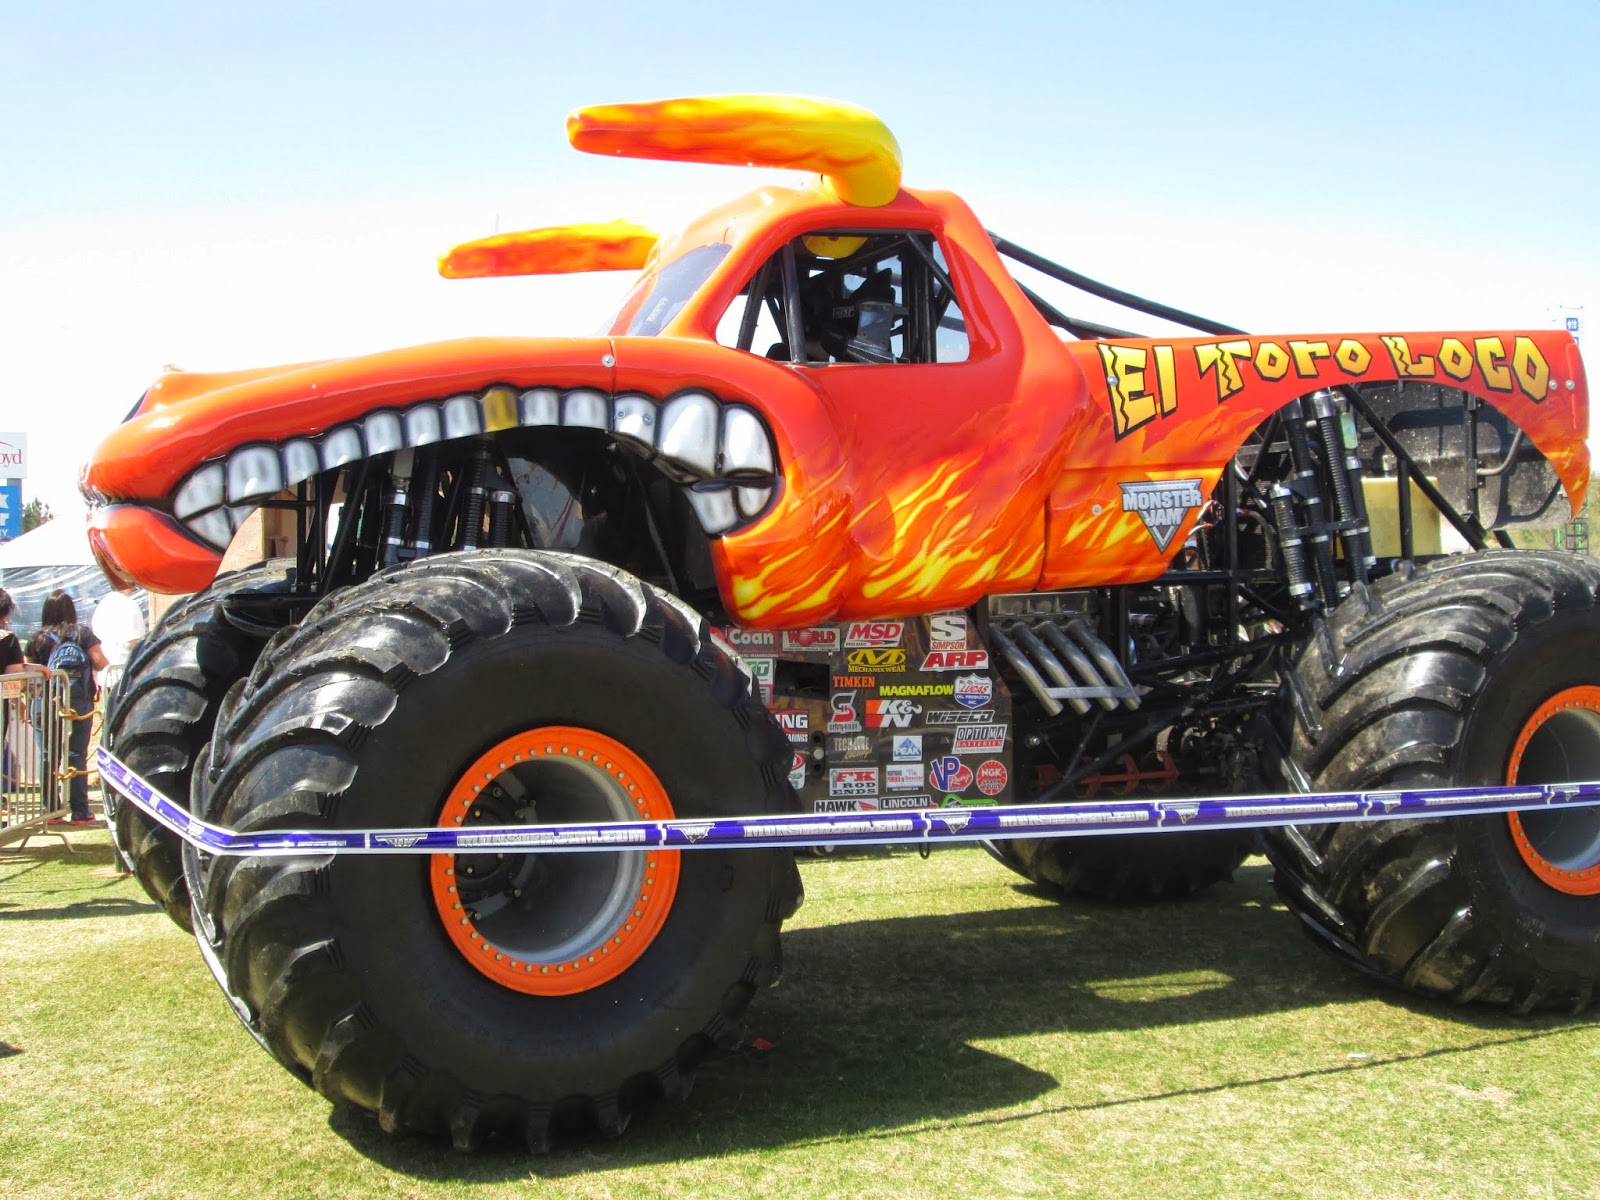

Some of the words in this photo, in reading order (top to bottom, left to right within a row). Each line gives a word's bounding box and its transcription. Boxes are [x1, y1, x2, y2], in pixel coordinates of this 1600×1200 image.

[1096, 342, 1178, 442] El
[1123, 489, 1202, 511] MONSTER
[1141, 508, 1184, 527] JAM
[729, 629, 774, 645] Coan
[788, 629, 836, 646] WORLD
[849, 624, 901, 639] MSD
[932, 641, 965, 649] SIMPSON
[924, 652, 987, 668] ARP
[833, 677, 875, 687] TIMKEN
[880, 684, 954, 696] MAGNAFLOW
[960, 685, 989, 694] LUCAS
[958, 727, 1003, 740] OPTIMA
[895, 747, 919, 755] PEAK
[837, 772, 875, 782] FK
[931, 757, 960, 792] VP
[981, 769, 1001, 777] NGK
[815, 801, 857, 812] HAWK
[883, 798, 928, 808] LINCOLN
